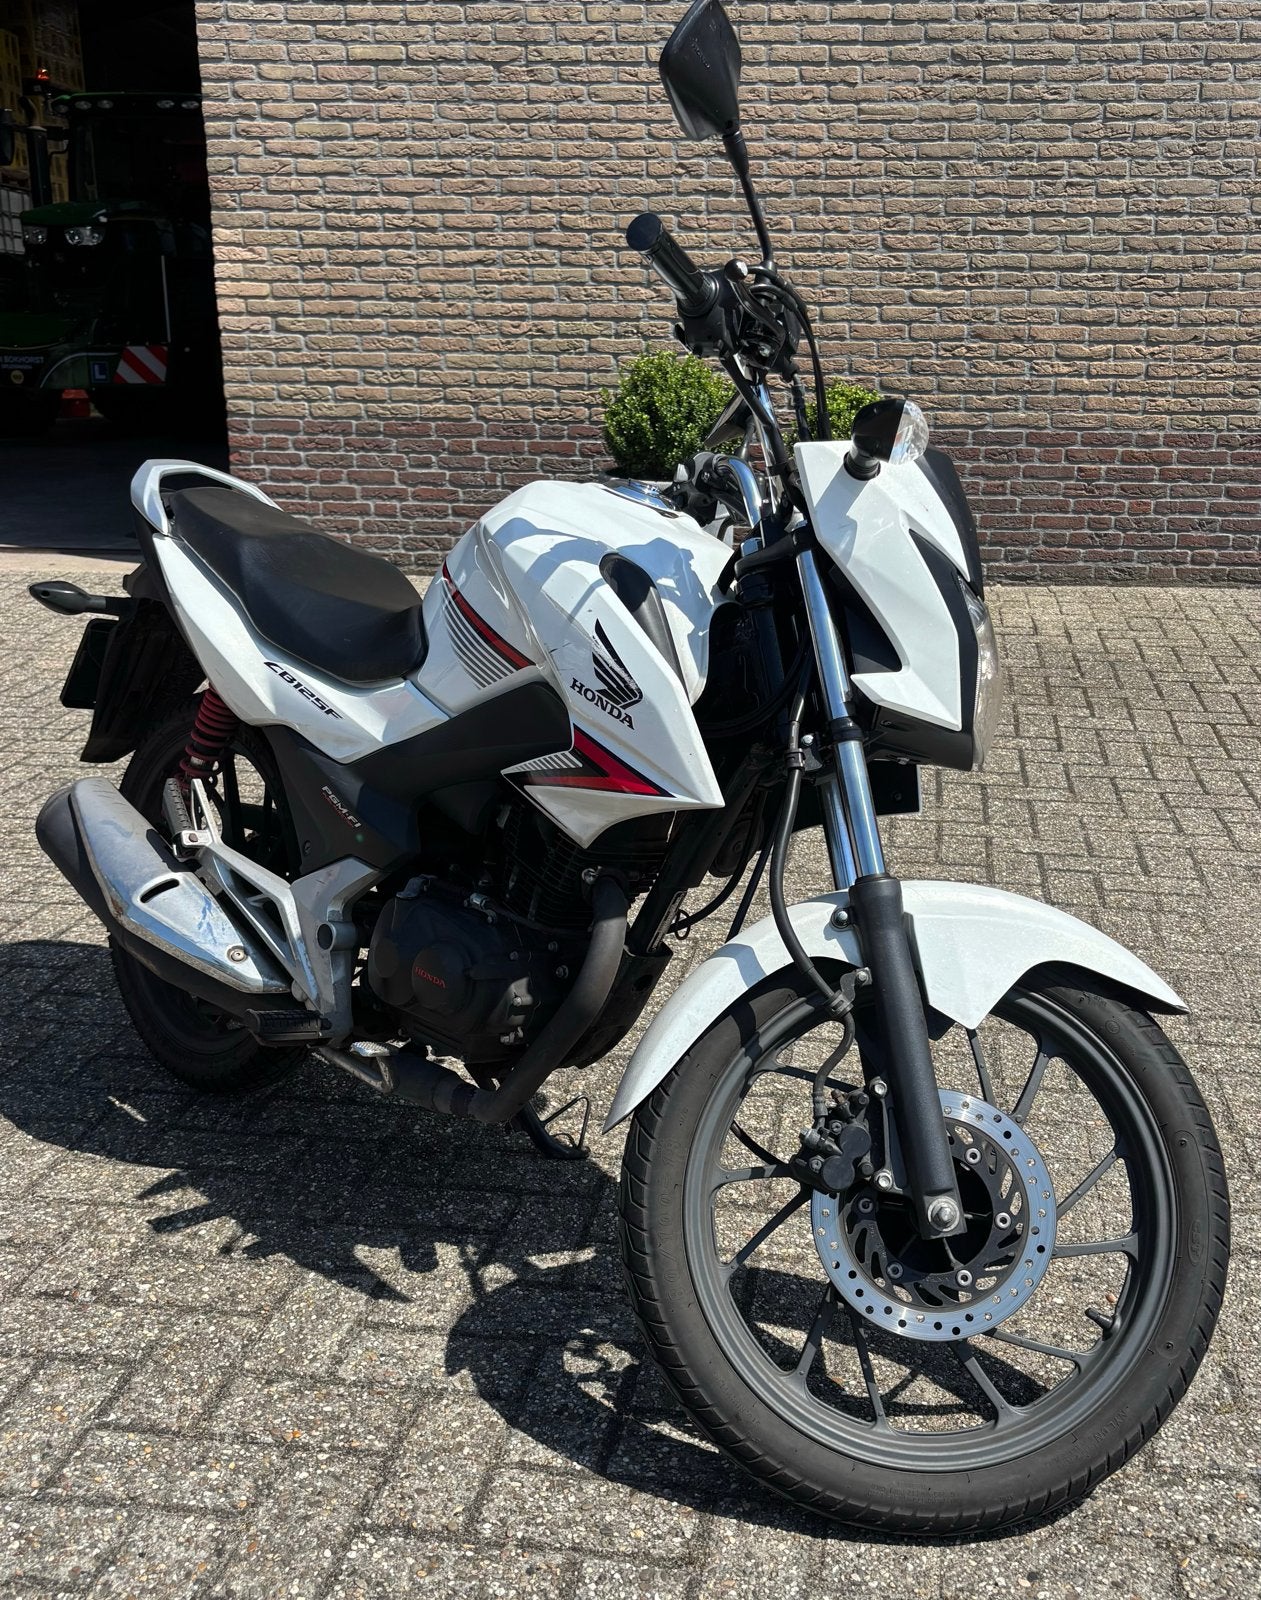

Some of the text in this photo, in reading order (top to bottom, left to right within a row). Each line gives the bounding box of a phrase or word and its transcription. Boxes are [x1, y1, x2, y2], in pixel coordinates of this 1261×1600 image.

[263, 662, 343, 719] CB125F
[570, 677, 635, 730] HONDA
[415, 966, 446, 988] HONDA
